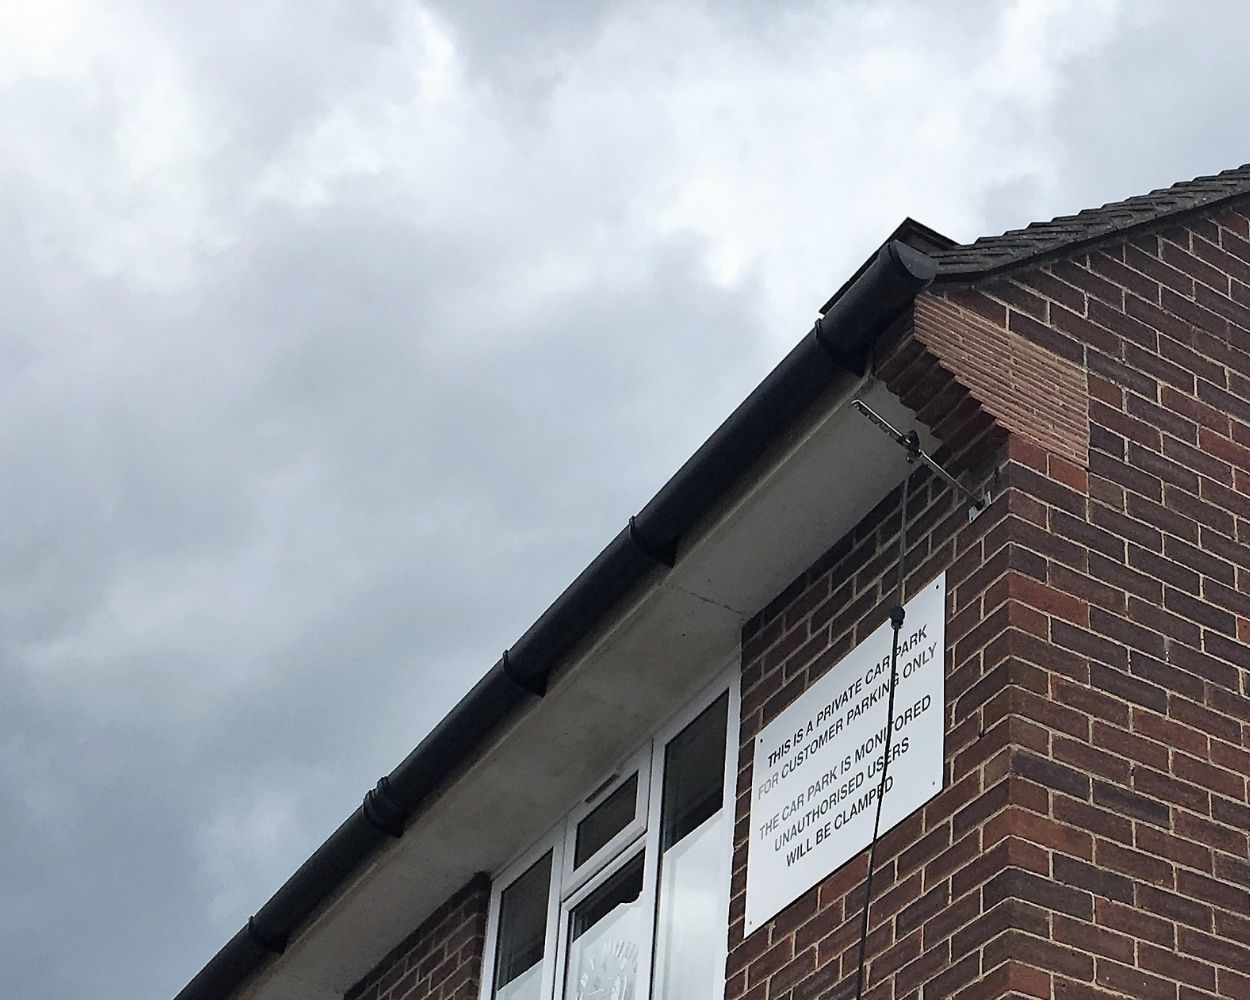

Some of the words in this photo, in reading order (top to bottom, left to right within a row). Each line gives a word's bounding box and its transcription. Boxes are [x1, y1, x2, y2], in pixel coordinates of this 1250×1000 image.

[759, 771, 779, 800] FOR
[782, 718, 843, 779] CUSTOMER
[903, 642, 937, 679] ONLY
[760, 813, 780, 840] THE
[782, 793, 804, 821] CAR
[807, 766, 838, 801] PARK
[840, 756, 852, 775] IS
[855, 695, 931, 763] MONIORED
[768, 741, 791, 768] THIS
[793, 730, 804, 747] IS
[806, 720, 814, 738] A
[816, 677, 863, 728] PRIVATE
[865, 655, 890, 684] CAR
[895, 624, 927, 657] PARK
[775, 772, 864, 851] UNAUTHORISED
[868, 737, 909, 779] USERS
[786, 838, 812, 867] WILL
[816, 822, 831, 845] BE
